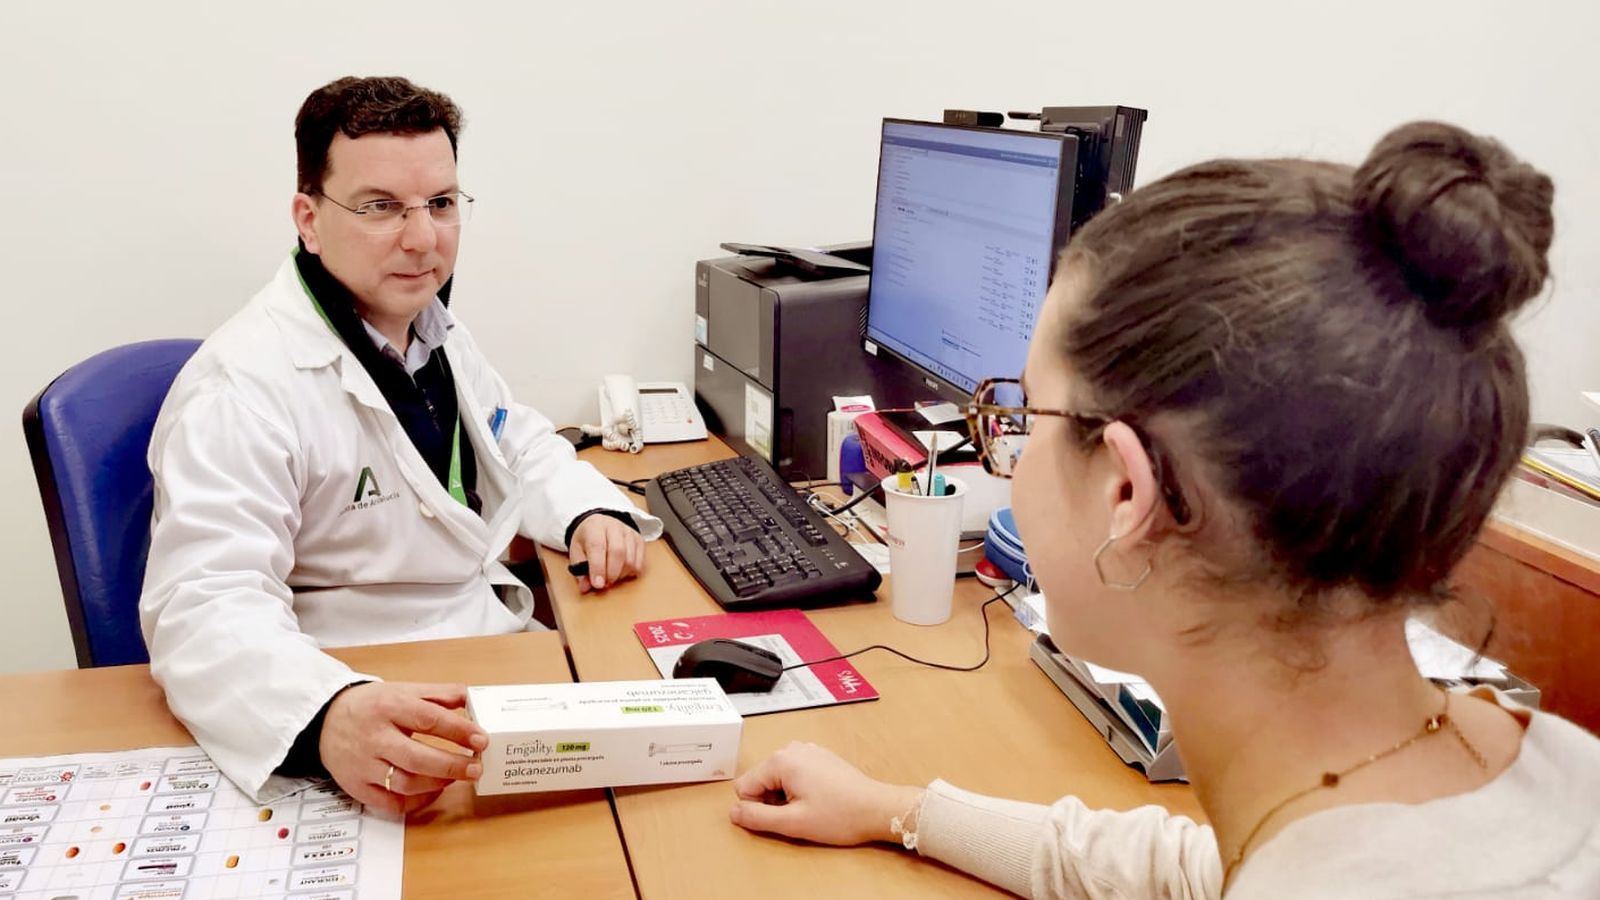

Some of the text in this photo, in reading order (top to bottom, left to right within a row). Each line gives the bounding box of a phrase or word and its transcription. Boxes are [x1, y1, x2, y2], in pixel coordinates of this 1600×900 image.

[358, 501, 368, 509] de
[648, 625, 671, 643] 2025
[505, 739, 587, 757] Emgality 120 mg
[504, 764, 582, 779] galcanezumab
